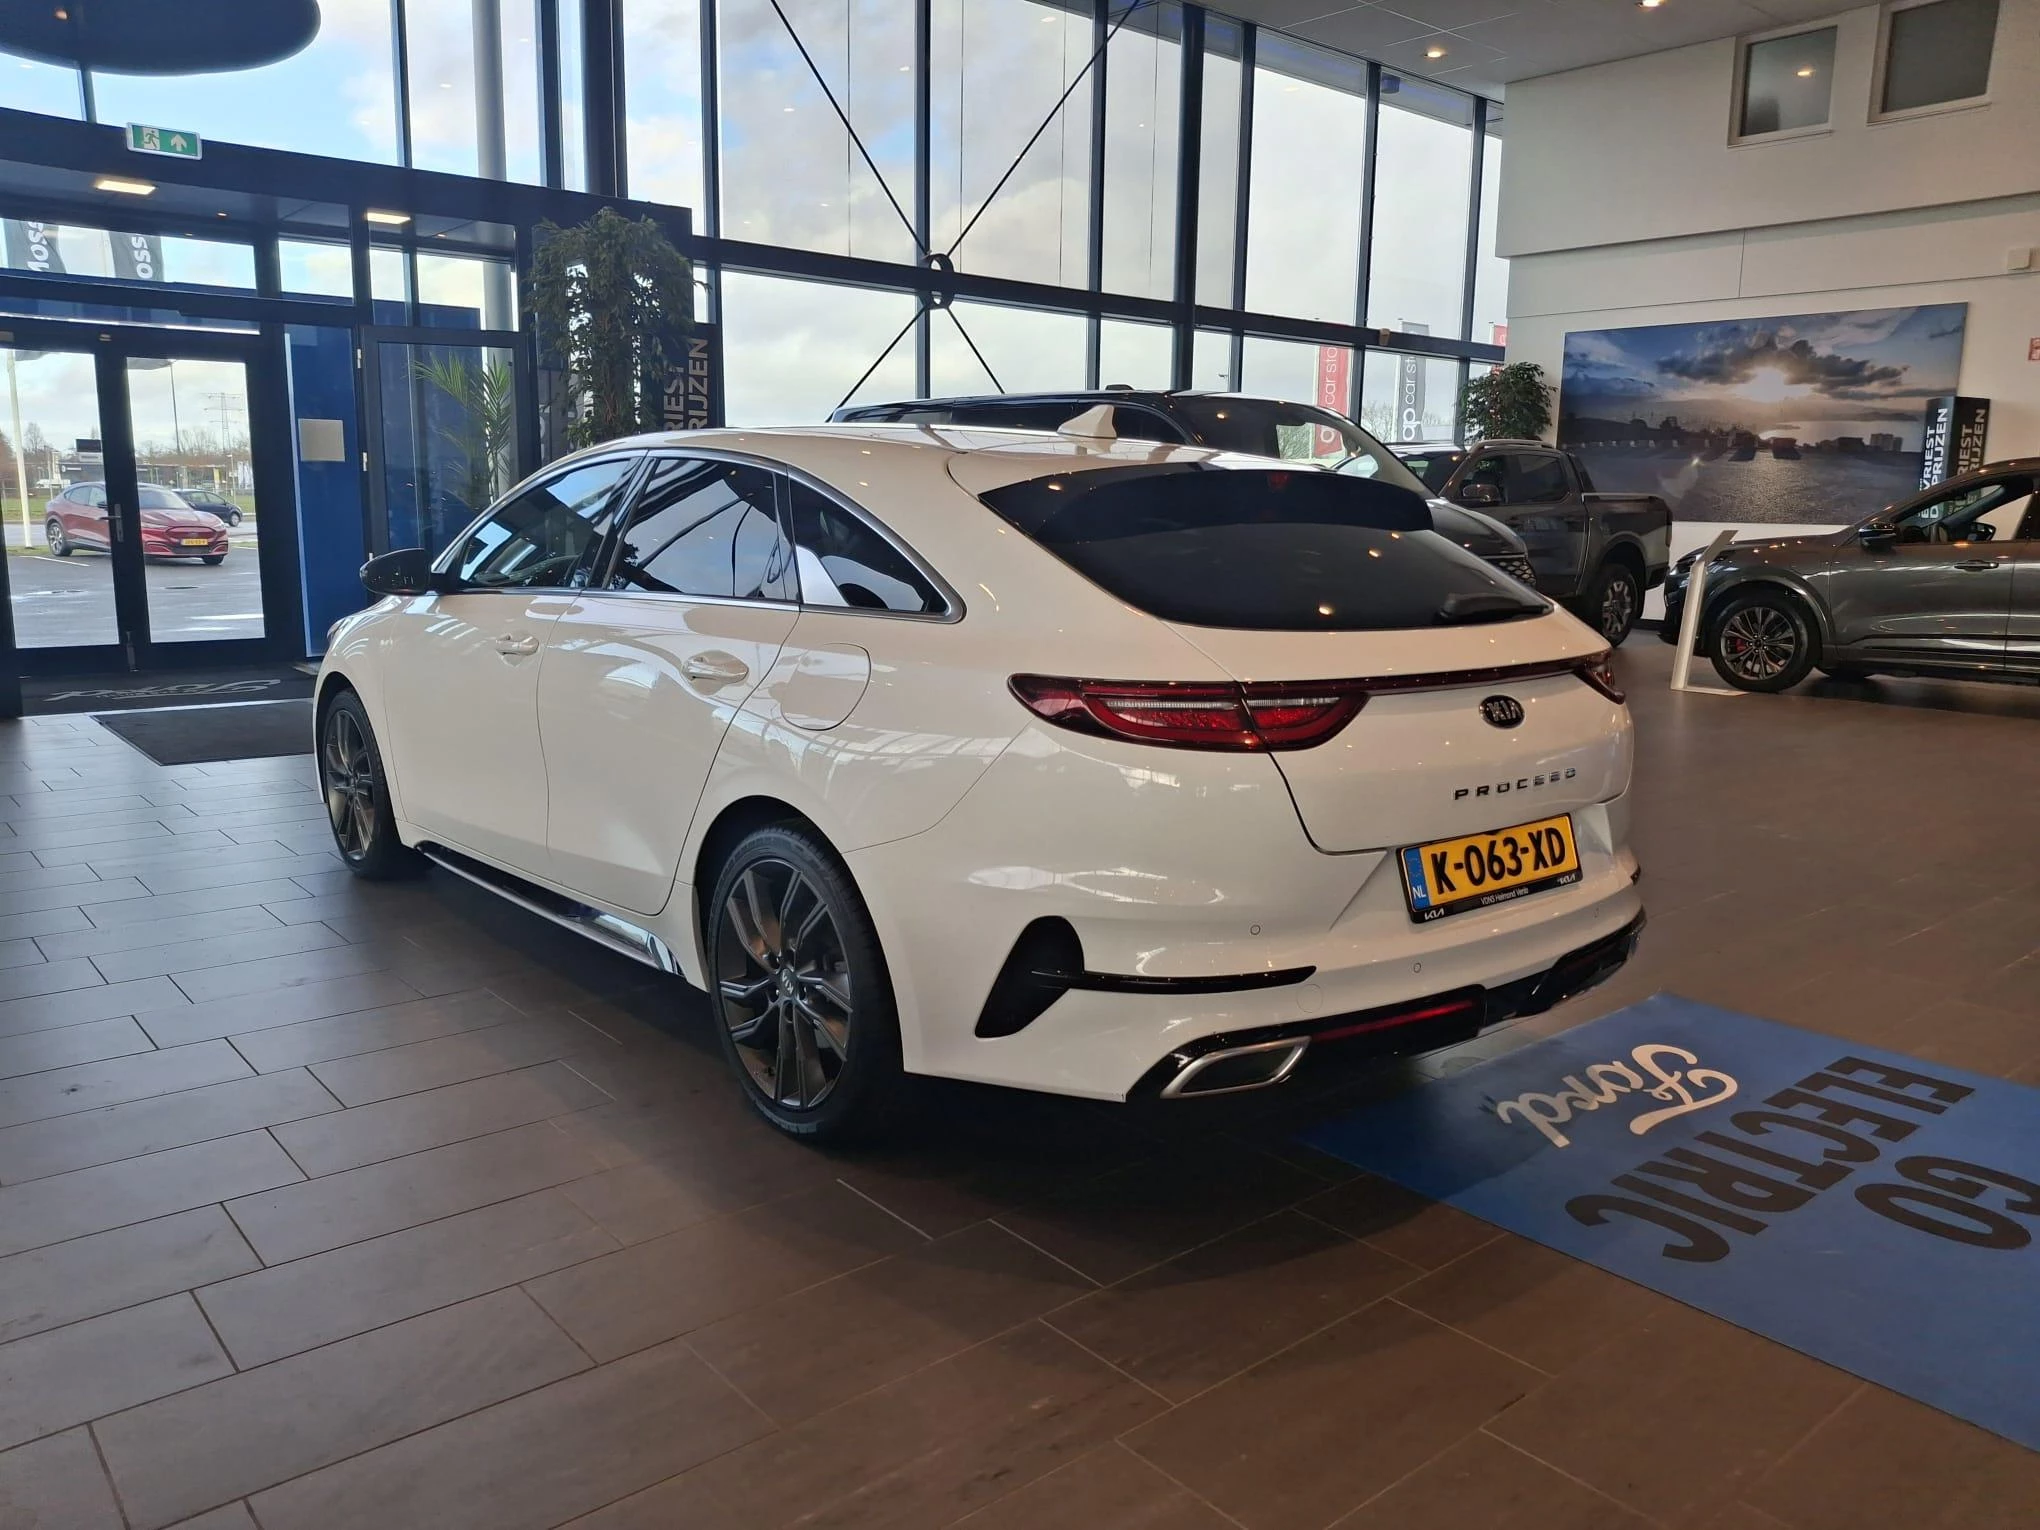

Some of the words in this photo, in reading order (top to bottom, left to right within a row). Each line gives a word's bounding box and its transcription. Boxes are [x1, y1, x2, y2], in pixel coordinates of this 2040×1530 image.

[1325, 375, 1337, 405] car
[1405, 377, 1416, 405] car
[1487, 700, 1521, 722] KIA
[1455, 768, 1576, 800] PROCEED
[1412, 886, 1427, 898] NL
[1431, 827, 1566, 895] K-063-XD
[1424, 908, 1445, 921] KIA
[1497, 1044, 1738, 1148] Ford
[1565, 1056, 1976, 1262] ELECTRIC
[1855, 1155, 2040, 1250] GO
